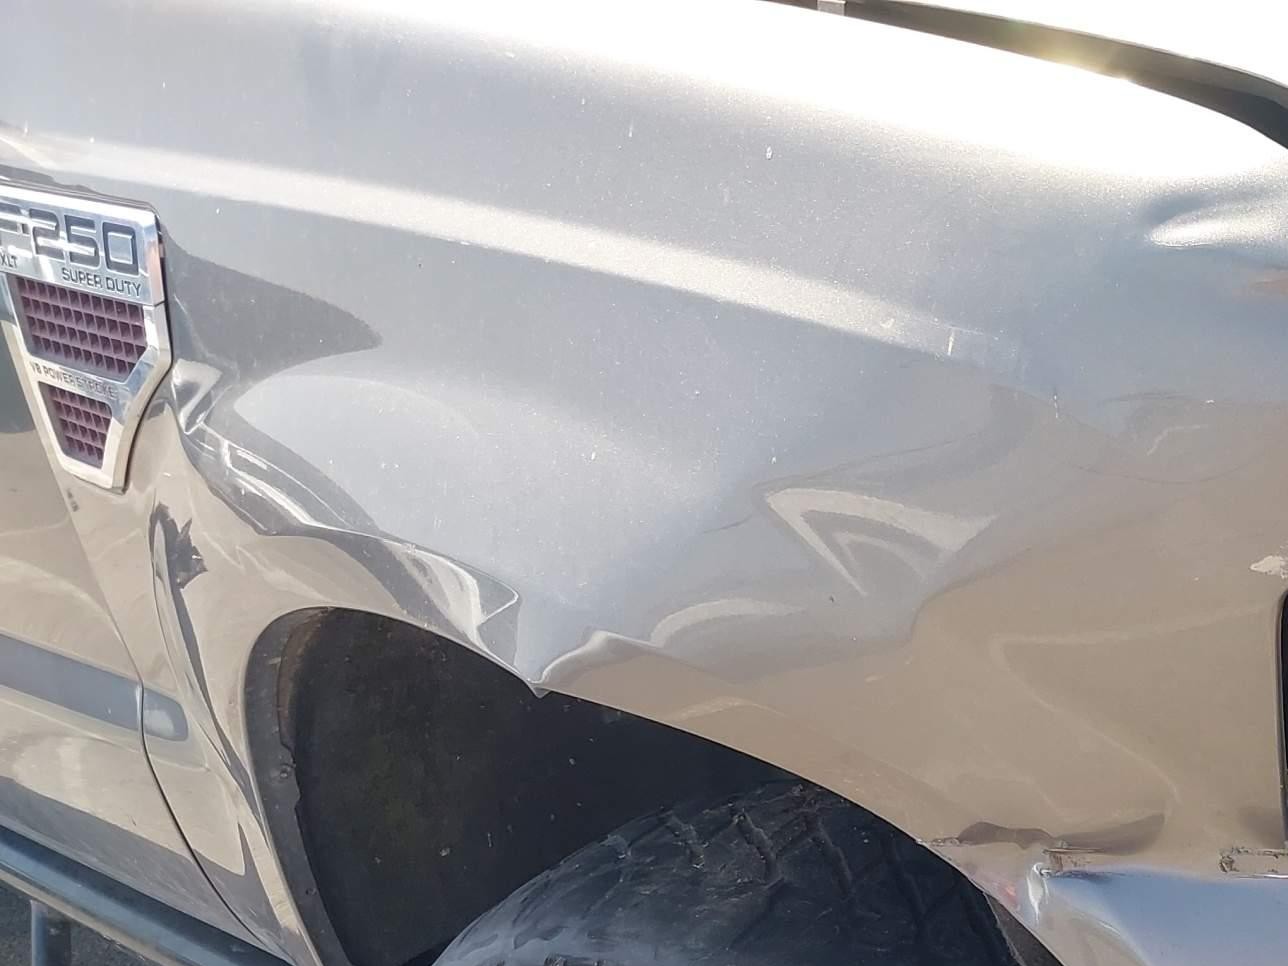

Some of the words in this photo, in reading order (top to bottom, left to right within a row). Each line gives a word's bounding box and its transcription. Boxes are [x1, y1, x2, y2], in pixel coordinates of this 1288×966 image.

[0, 253, 18, 268] XLT
[61, 266, 103, 289] SUPER
[105, 276, 142, 297] DUTY
